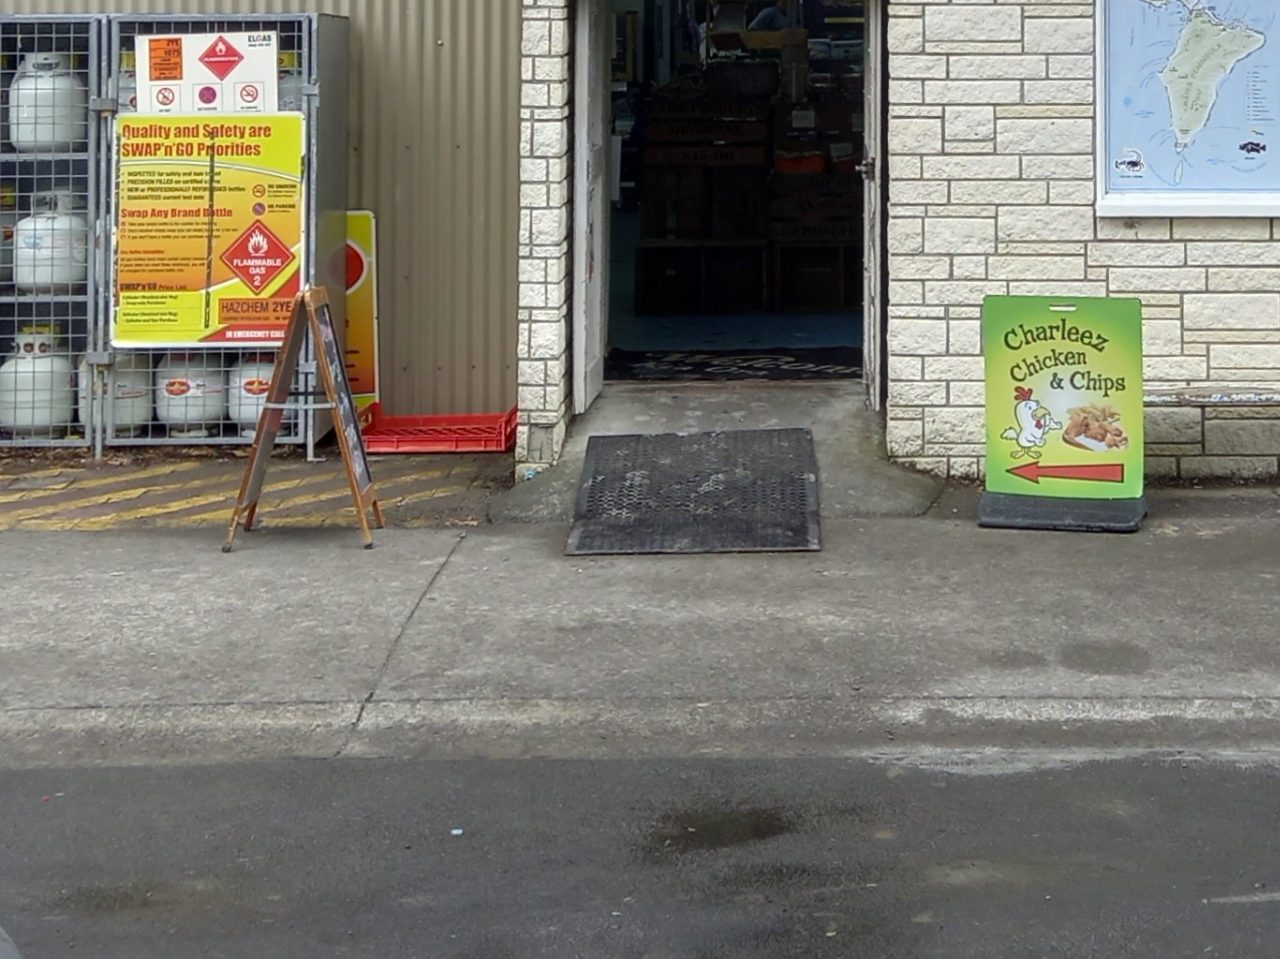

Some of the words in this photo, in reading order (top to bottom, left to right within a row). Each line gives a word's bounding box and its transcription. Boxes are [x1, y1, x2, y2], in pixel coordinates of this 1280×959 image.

[122, 123, 171, 140] Quality
[174, 124, 199, 138] and
[203, 123, 246, 139] Safety
[248, 125, 272, 138] are
[122, 142, 194, 157] SWAP'n'GO
[121, 208, 149, 219] Swap
[151, 208, 168, 219] Any
[171, 208, 200, 218] Brand
[233, 258, 282, 267] FLAMMABLE
[249, 266, 266, 274] GAS
[253, 276, 261, 286] 2
[221, 301, 269, 313] HAZCHEM
[272, 301, 292, 313] 2YE
[1004, 318, 1109, 353] Charleez
[1009, 349, 1087, 382] Chicken
[1050, 372, 1065, 390] &
[1070, 371, 1126, 398] Chips
